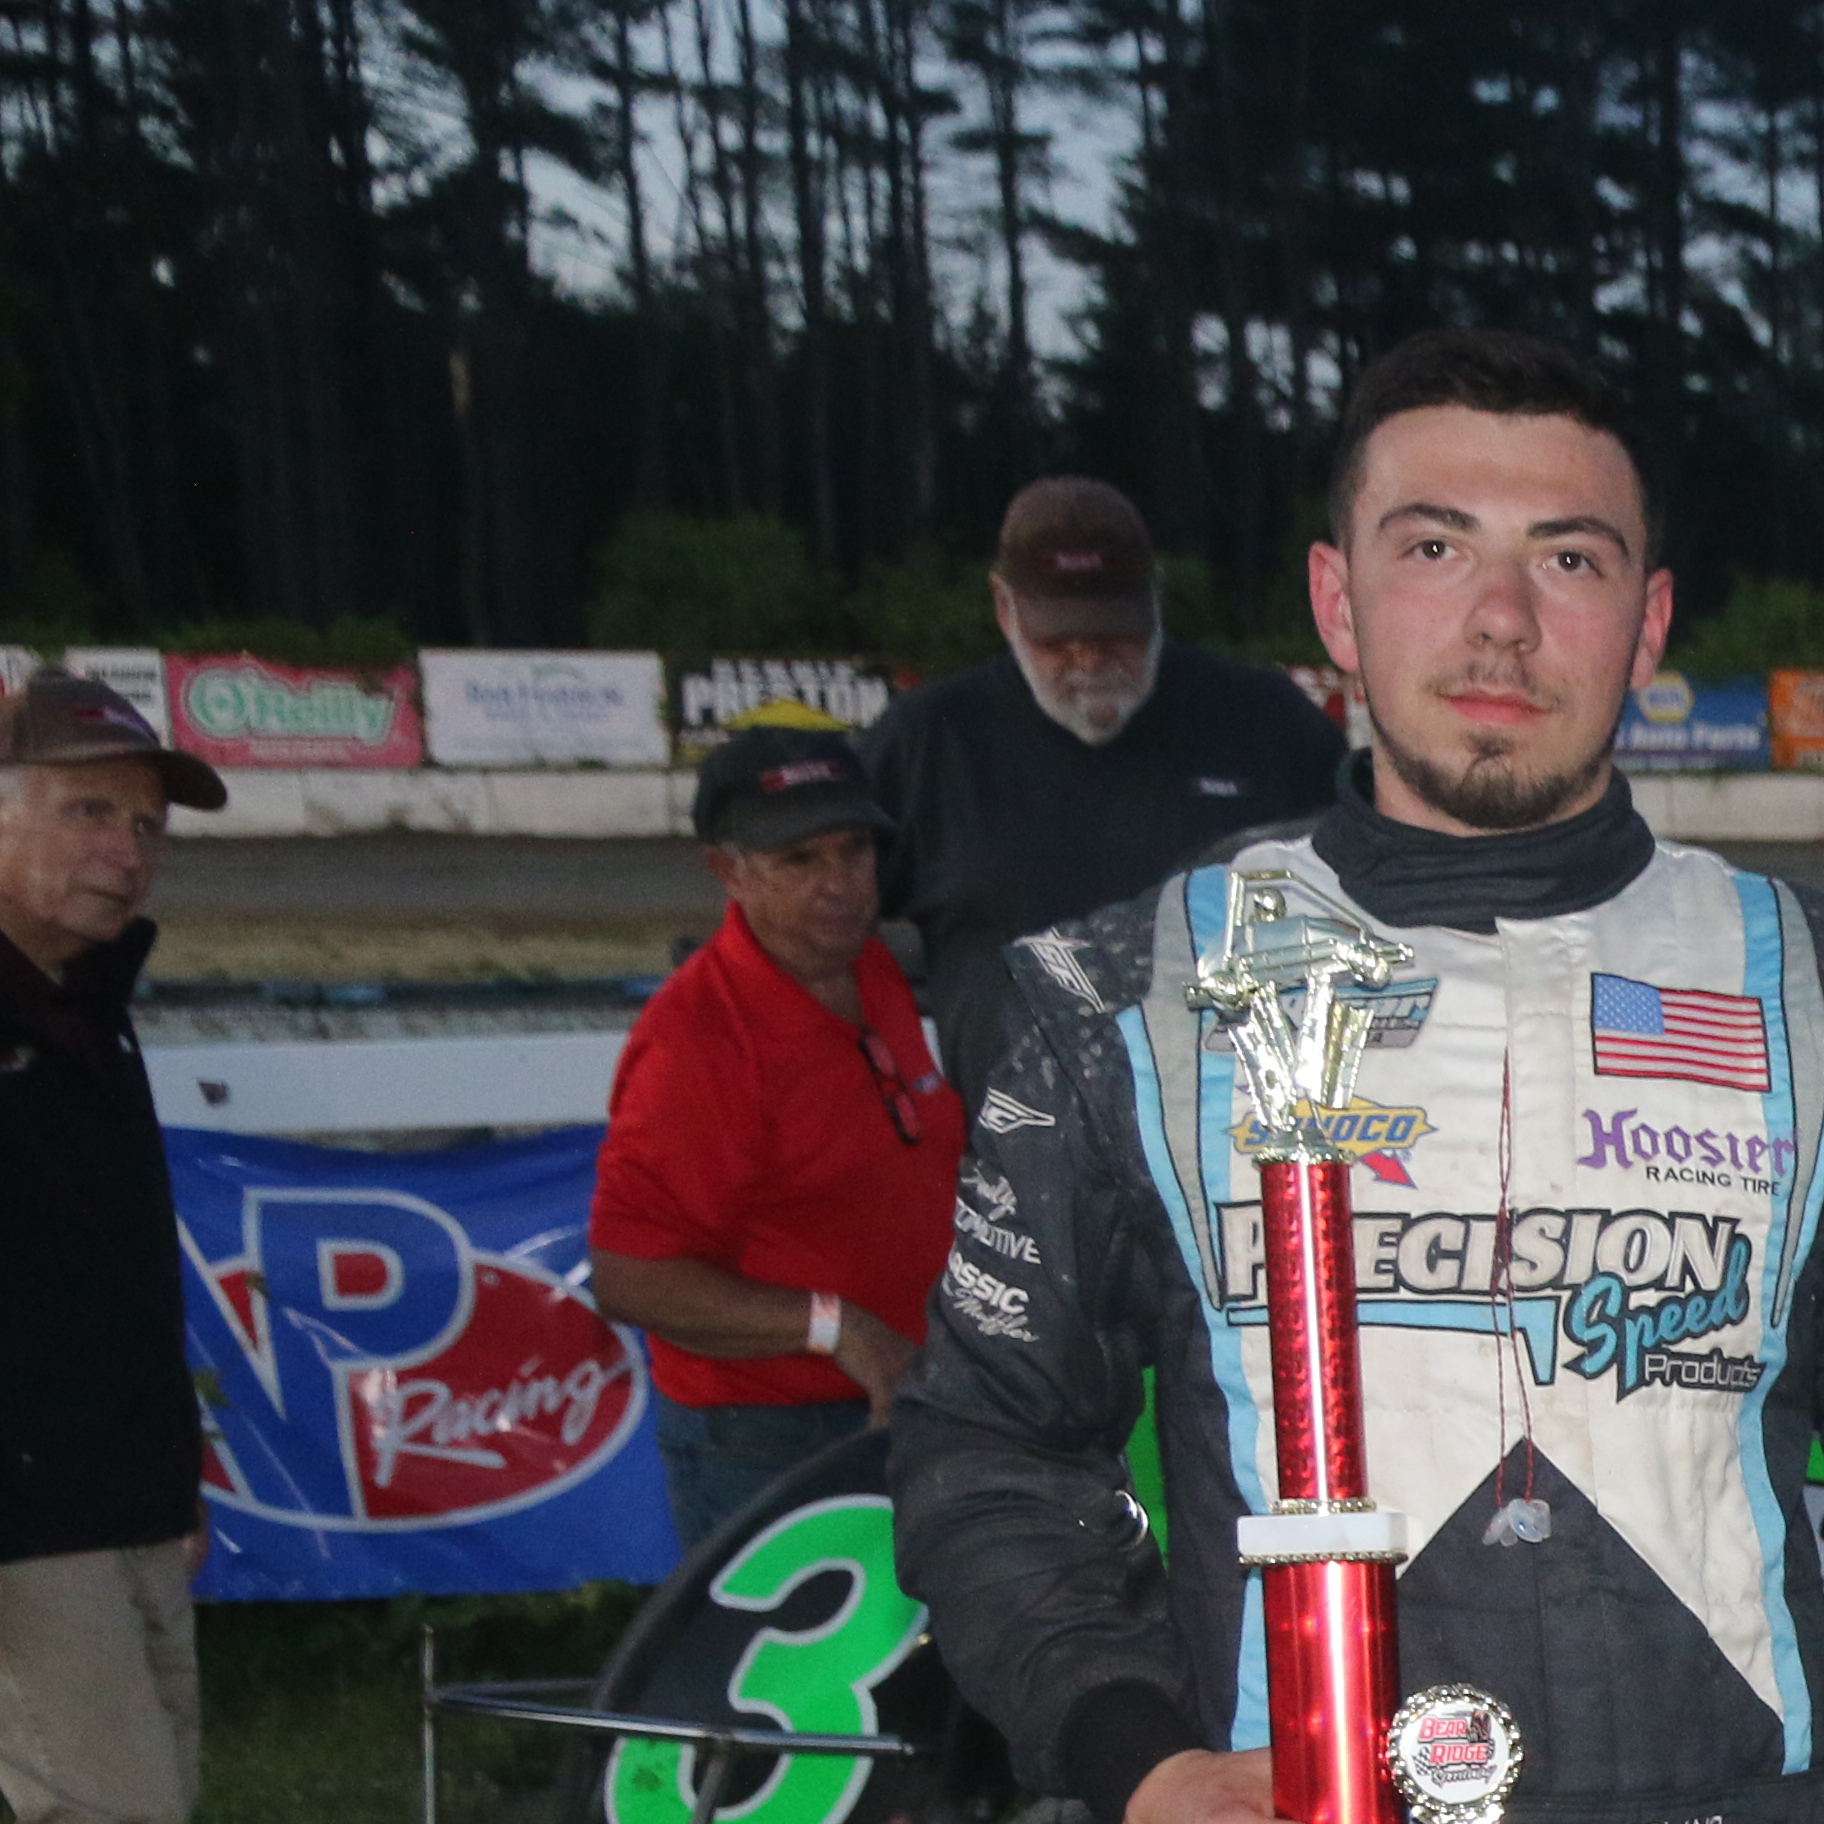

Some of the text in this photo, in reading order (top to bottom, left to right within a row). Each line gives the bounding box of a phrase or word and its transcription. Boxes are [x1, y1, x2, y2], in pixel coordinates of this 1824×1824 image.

[1244, 1114, 1418, 1146] SOCO
[1577, 1108, 1795, 1177] Hoosier
[1646, 1166, 1781, 1196] RACING TIRE
[1220, 1203, 1740, 1297] PECISION
[1568, 1240, 1750, 1396] Speed
[1643, 1351, 1760, 1391] Products
[373, 1357, 606, 1489] Racing
[1417, 1716, 1467, 1742] BEAR
[1429, 1743, 1489, 1764] RIDGE
